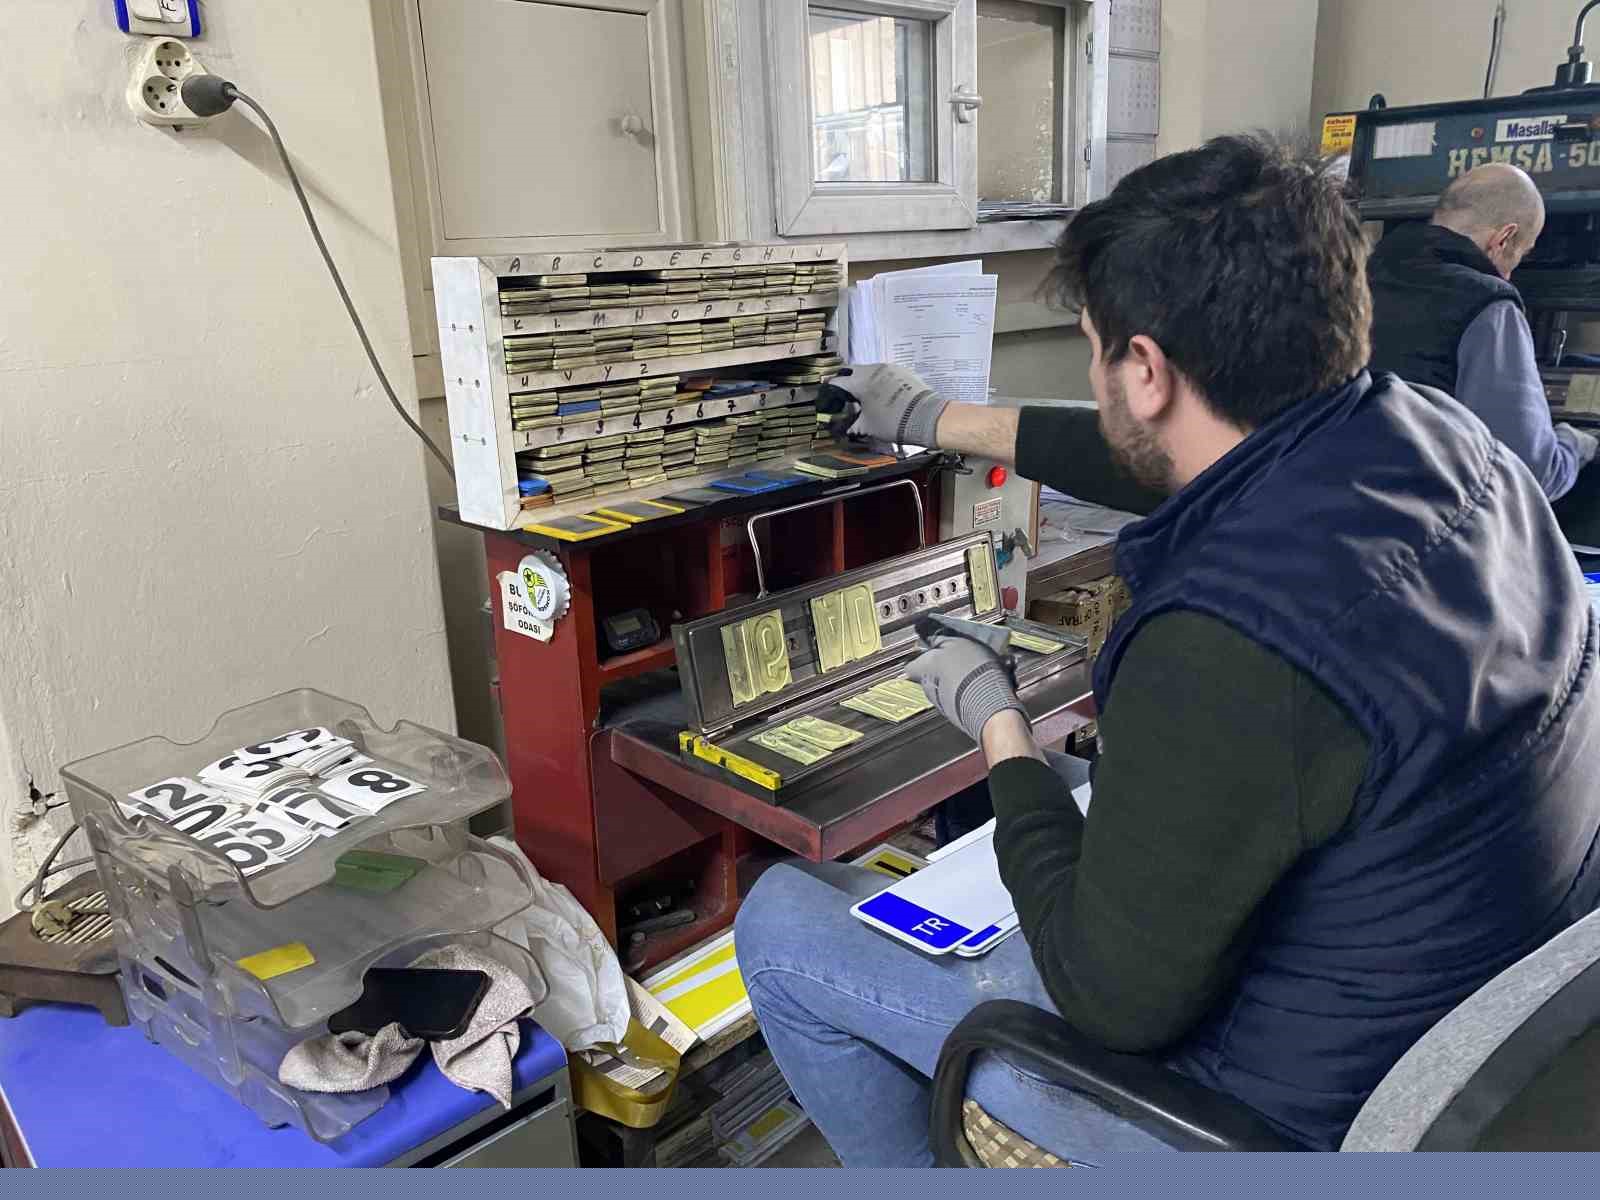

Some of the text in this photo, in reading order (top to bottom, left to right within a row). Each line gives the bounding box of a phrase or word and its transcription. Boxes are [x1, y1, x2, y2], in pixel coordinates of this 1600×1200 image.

[509, 257, 521, 272] A
[552, 256, 561, 271] B
[593, 256, 603, 268] C
[633, 255, 643, 267] D
[669, 252, 681, 265] E
[700, 252, 712, 265] F
[733, 248, 742, 261] G
[763, 247, 774, 260] H
[593, 312, 606, 326] M
[671, 309, 679, 319] O
[703, 304, 713, 317] P
[596, 419, 604, 434] 3
[633, 411, 642, 430] 4
[666, 407, 675, 424] 5
[696, 403, 704, 418] 6
[727, 399, 737, 413] 7
[347, 769, 411, 794] 8
[145, 783, 209, 811] 2
[911, 917, 950, 936] TR
